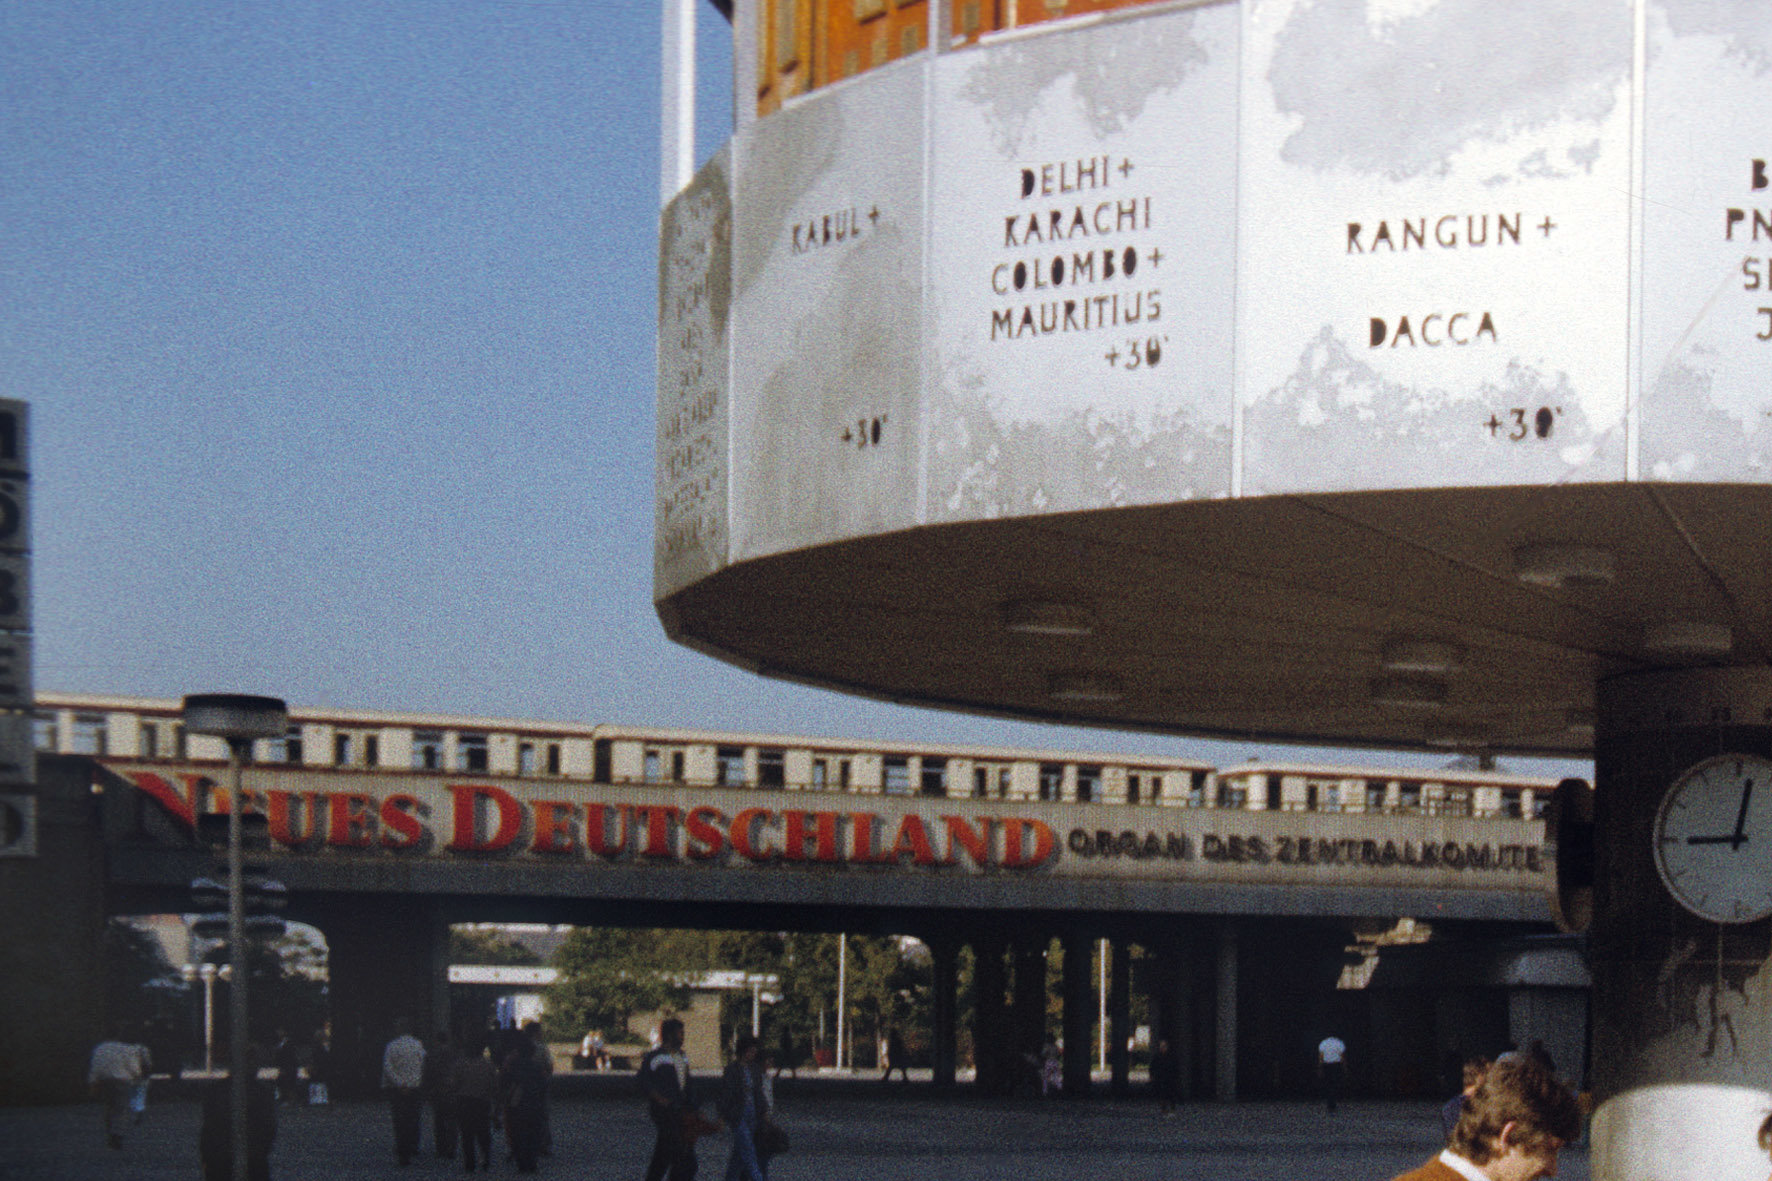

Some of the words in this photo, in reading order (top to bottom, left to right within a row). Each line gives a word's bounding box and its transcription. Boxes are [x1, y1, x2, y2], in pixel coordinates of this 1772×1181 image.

[1004, 196, 1151, 247] KARACHI
[990, 289, 1162, 342] MAURITIUS
[1369, 312, 1498, 349] DACCA
[446, 783, 1056, 868] DEUTSCHLAND
[1067, 828, 1188, 859] ORGAN
[1202, 834, 1273, 863] DES
